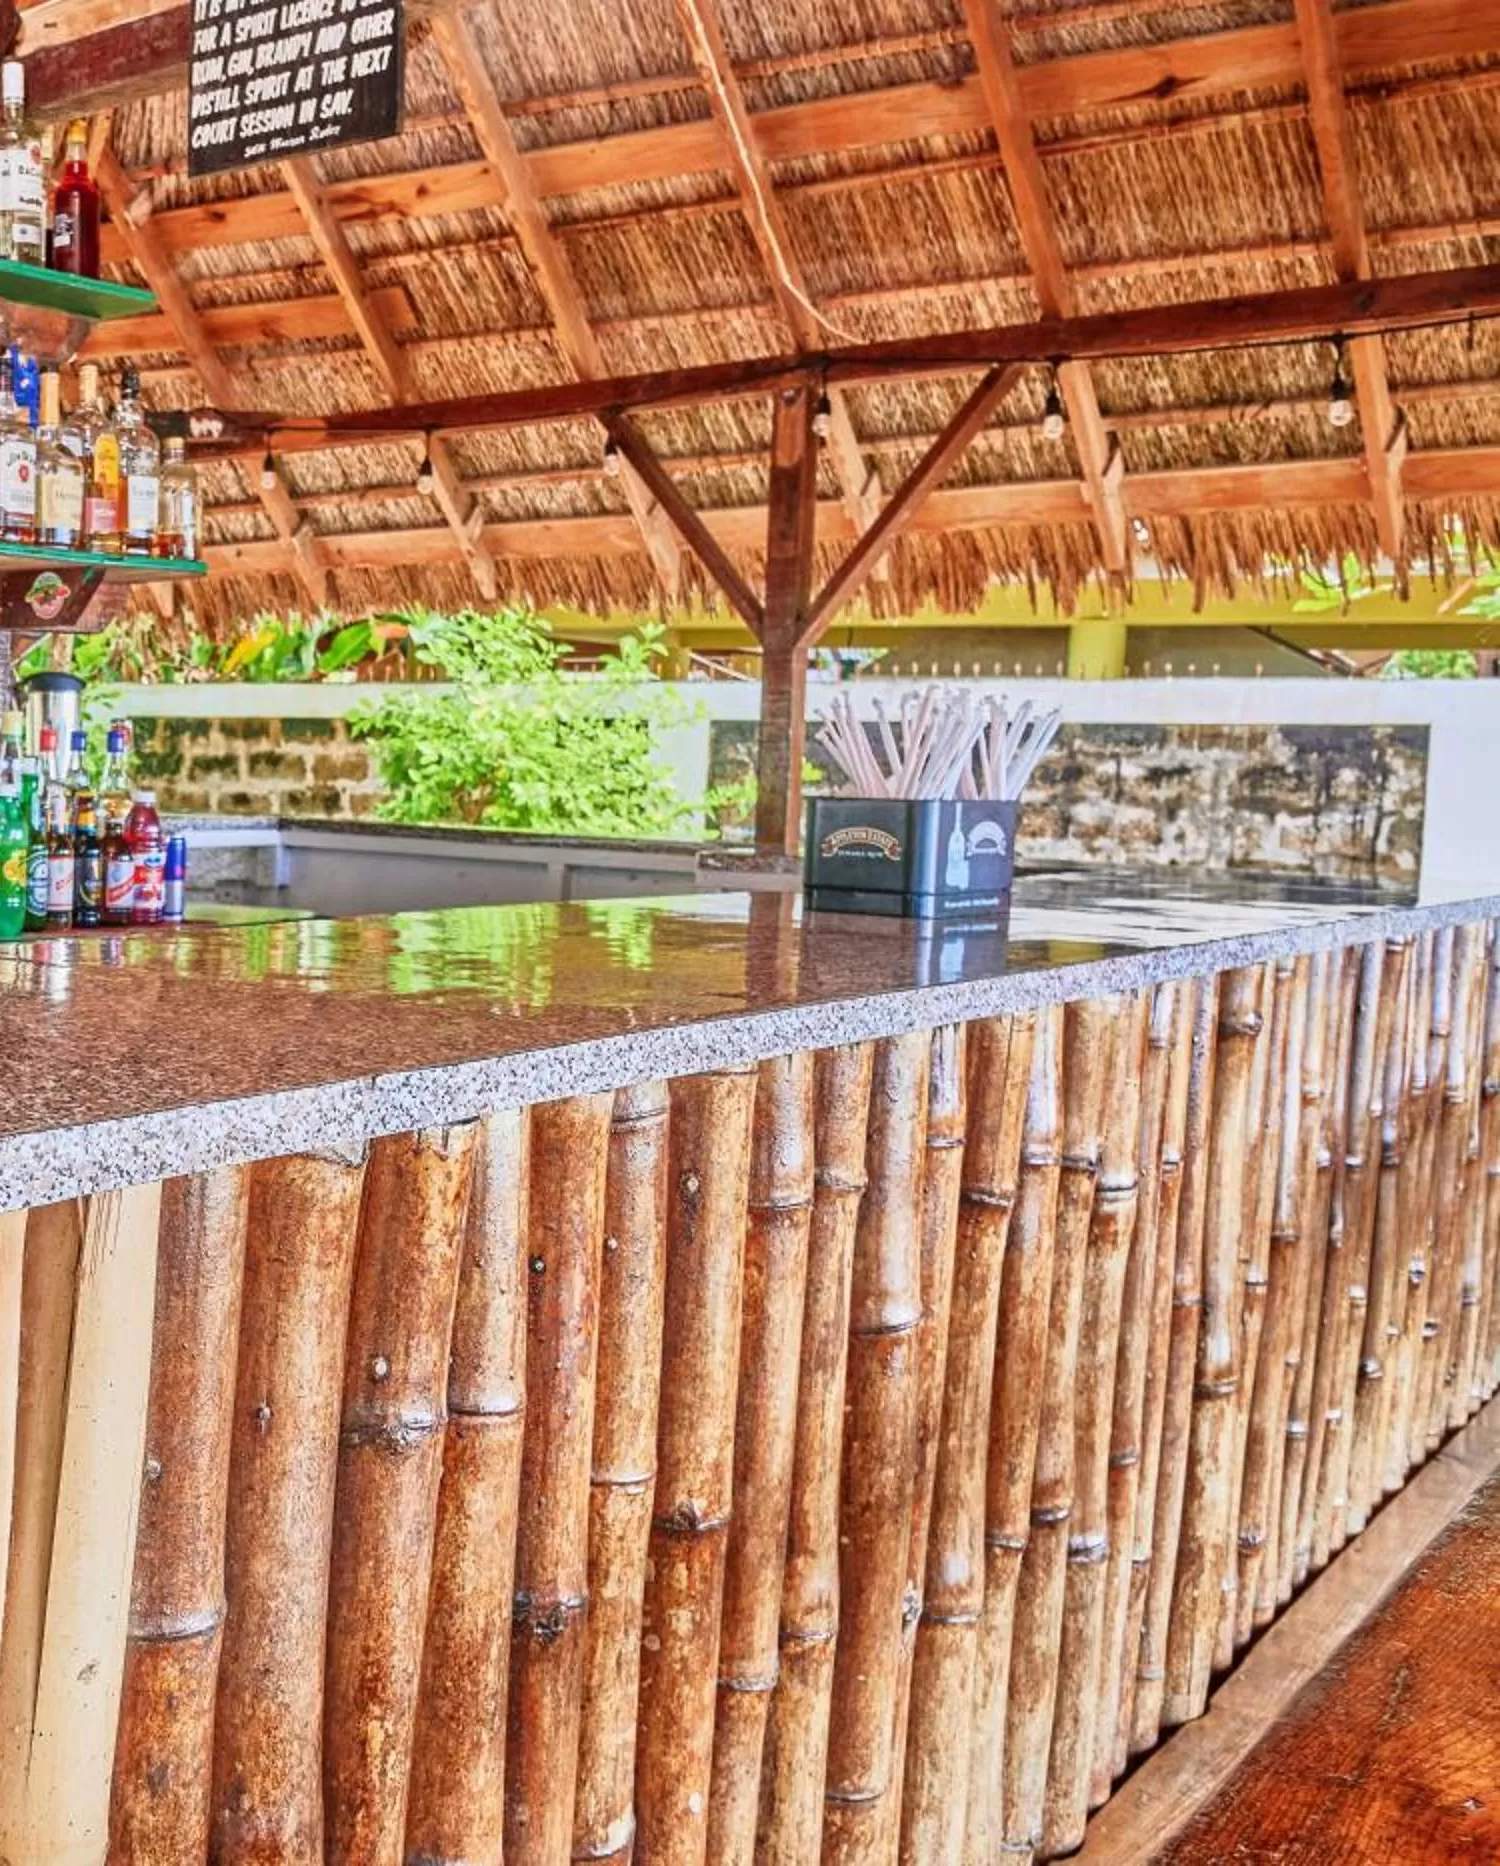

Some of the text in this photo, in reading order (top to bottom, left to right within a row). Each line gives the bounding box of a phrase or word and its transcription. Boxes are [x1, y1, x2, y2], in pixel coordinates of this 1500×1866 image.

[193, 25, 219, 55] FOR
[220, 21, 232, 47] A
[235, 7, 278, 43] SPIRIT
[280, 0, 335, 31] LICENCE
[255, 31, 313, 69] BRANDY
[314, 21, 347, 55] AND
[351, 7, 395, 45] OTHER
[192, 45, 393, 119] DISTILL SPIRIT AT THE NEXT
[192, 117, 238, 150] COURT
[240, 102, 296, 138] SESSION
[298, 98, 317, 124] IN
